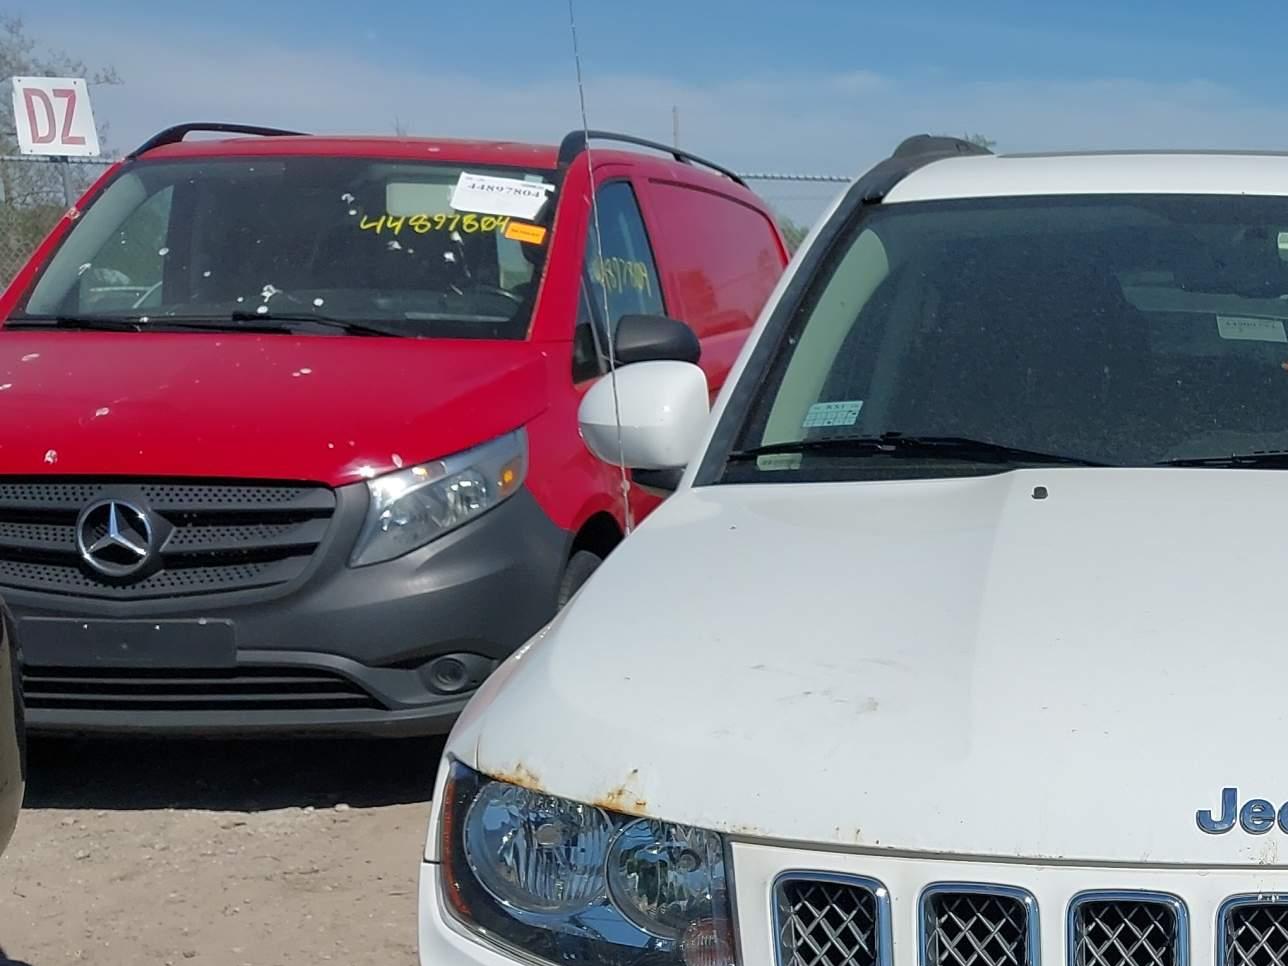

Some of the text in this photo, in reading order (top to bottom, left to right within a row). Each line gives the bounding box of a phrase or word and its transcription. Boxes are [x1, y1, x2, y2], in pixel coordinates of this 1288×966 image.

[22, 87, 87, 145] DZ
[466, 182, 541, 199] 44897804
[359, 212, 511, 236] 44897804
